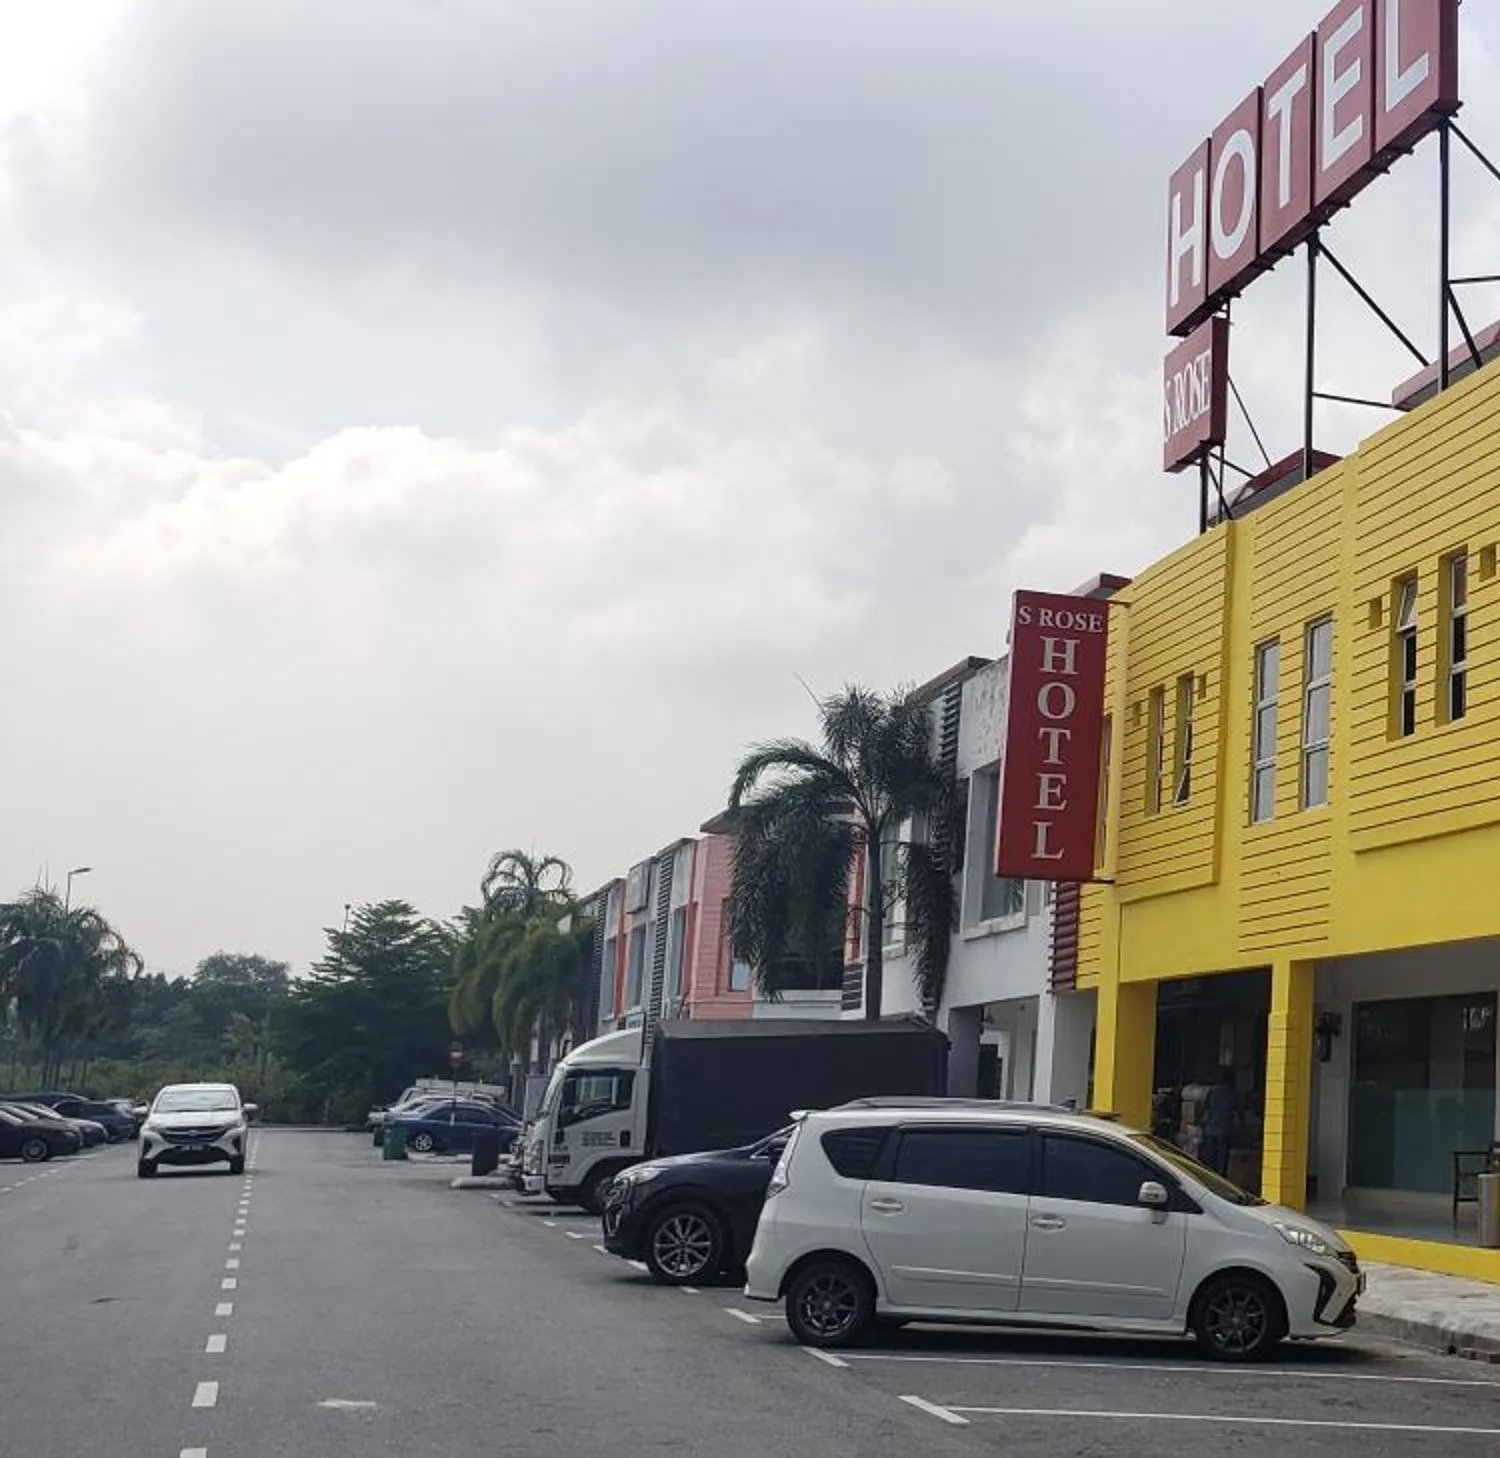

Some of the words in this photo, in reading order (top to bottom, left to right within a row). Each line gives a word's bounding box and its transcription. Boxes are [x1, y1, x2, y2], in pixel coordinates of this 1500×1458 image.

[1170, 0, 1429, 308] HOTEL
[1173, 350, 1210, 433] ROSE
[1018, 605, 1032, 625] S
[1038, 608, 1103, 632] ROSE
[1031, 636, 1080, 860] HOTEL
